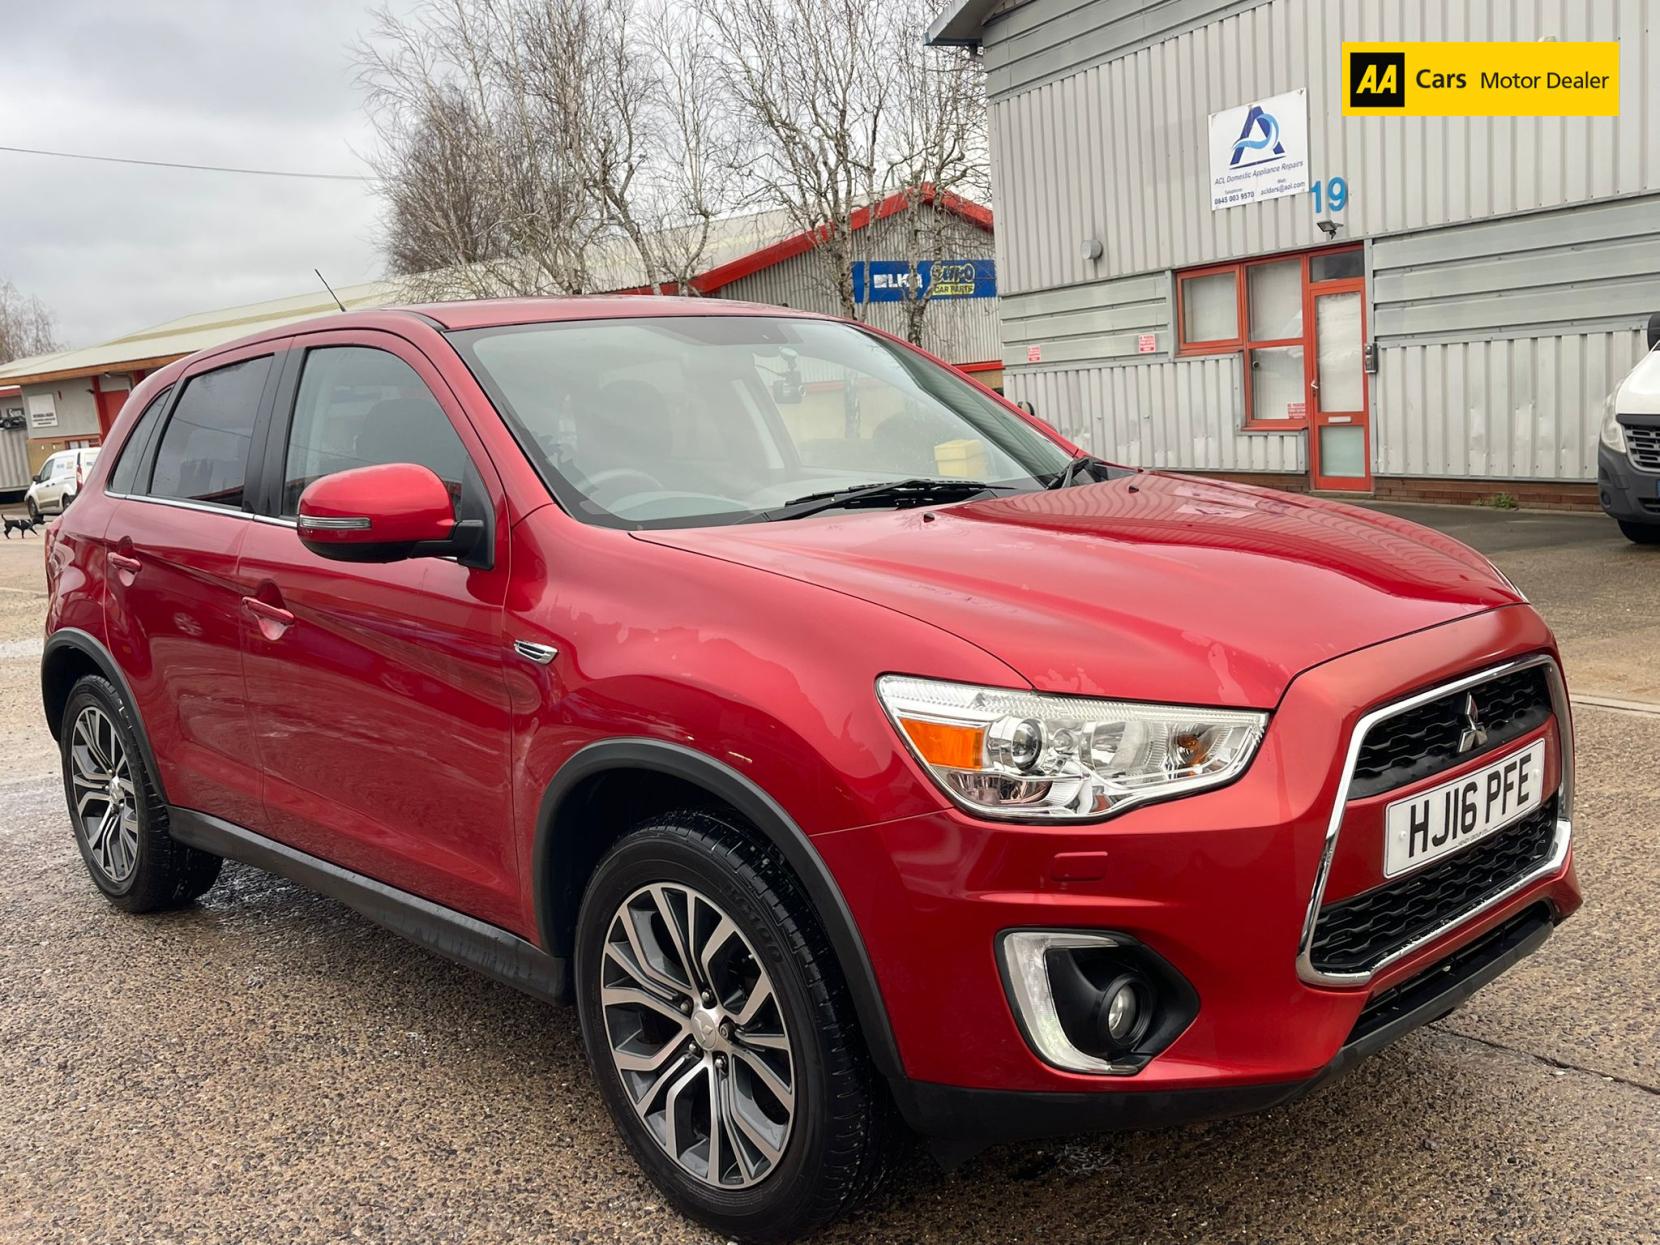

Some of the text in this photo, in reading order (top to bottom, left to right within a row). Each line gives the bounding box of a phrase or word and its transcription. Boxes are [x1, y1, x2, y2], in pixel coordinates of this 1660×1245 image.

[1214, 160, 1304, 186] ACL Domestic Appliance Repairs
[1310, 176, 1347, 214] 19
[1409, 753, 1532, 858] HJ16 PFE
